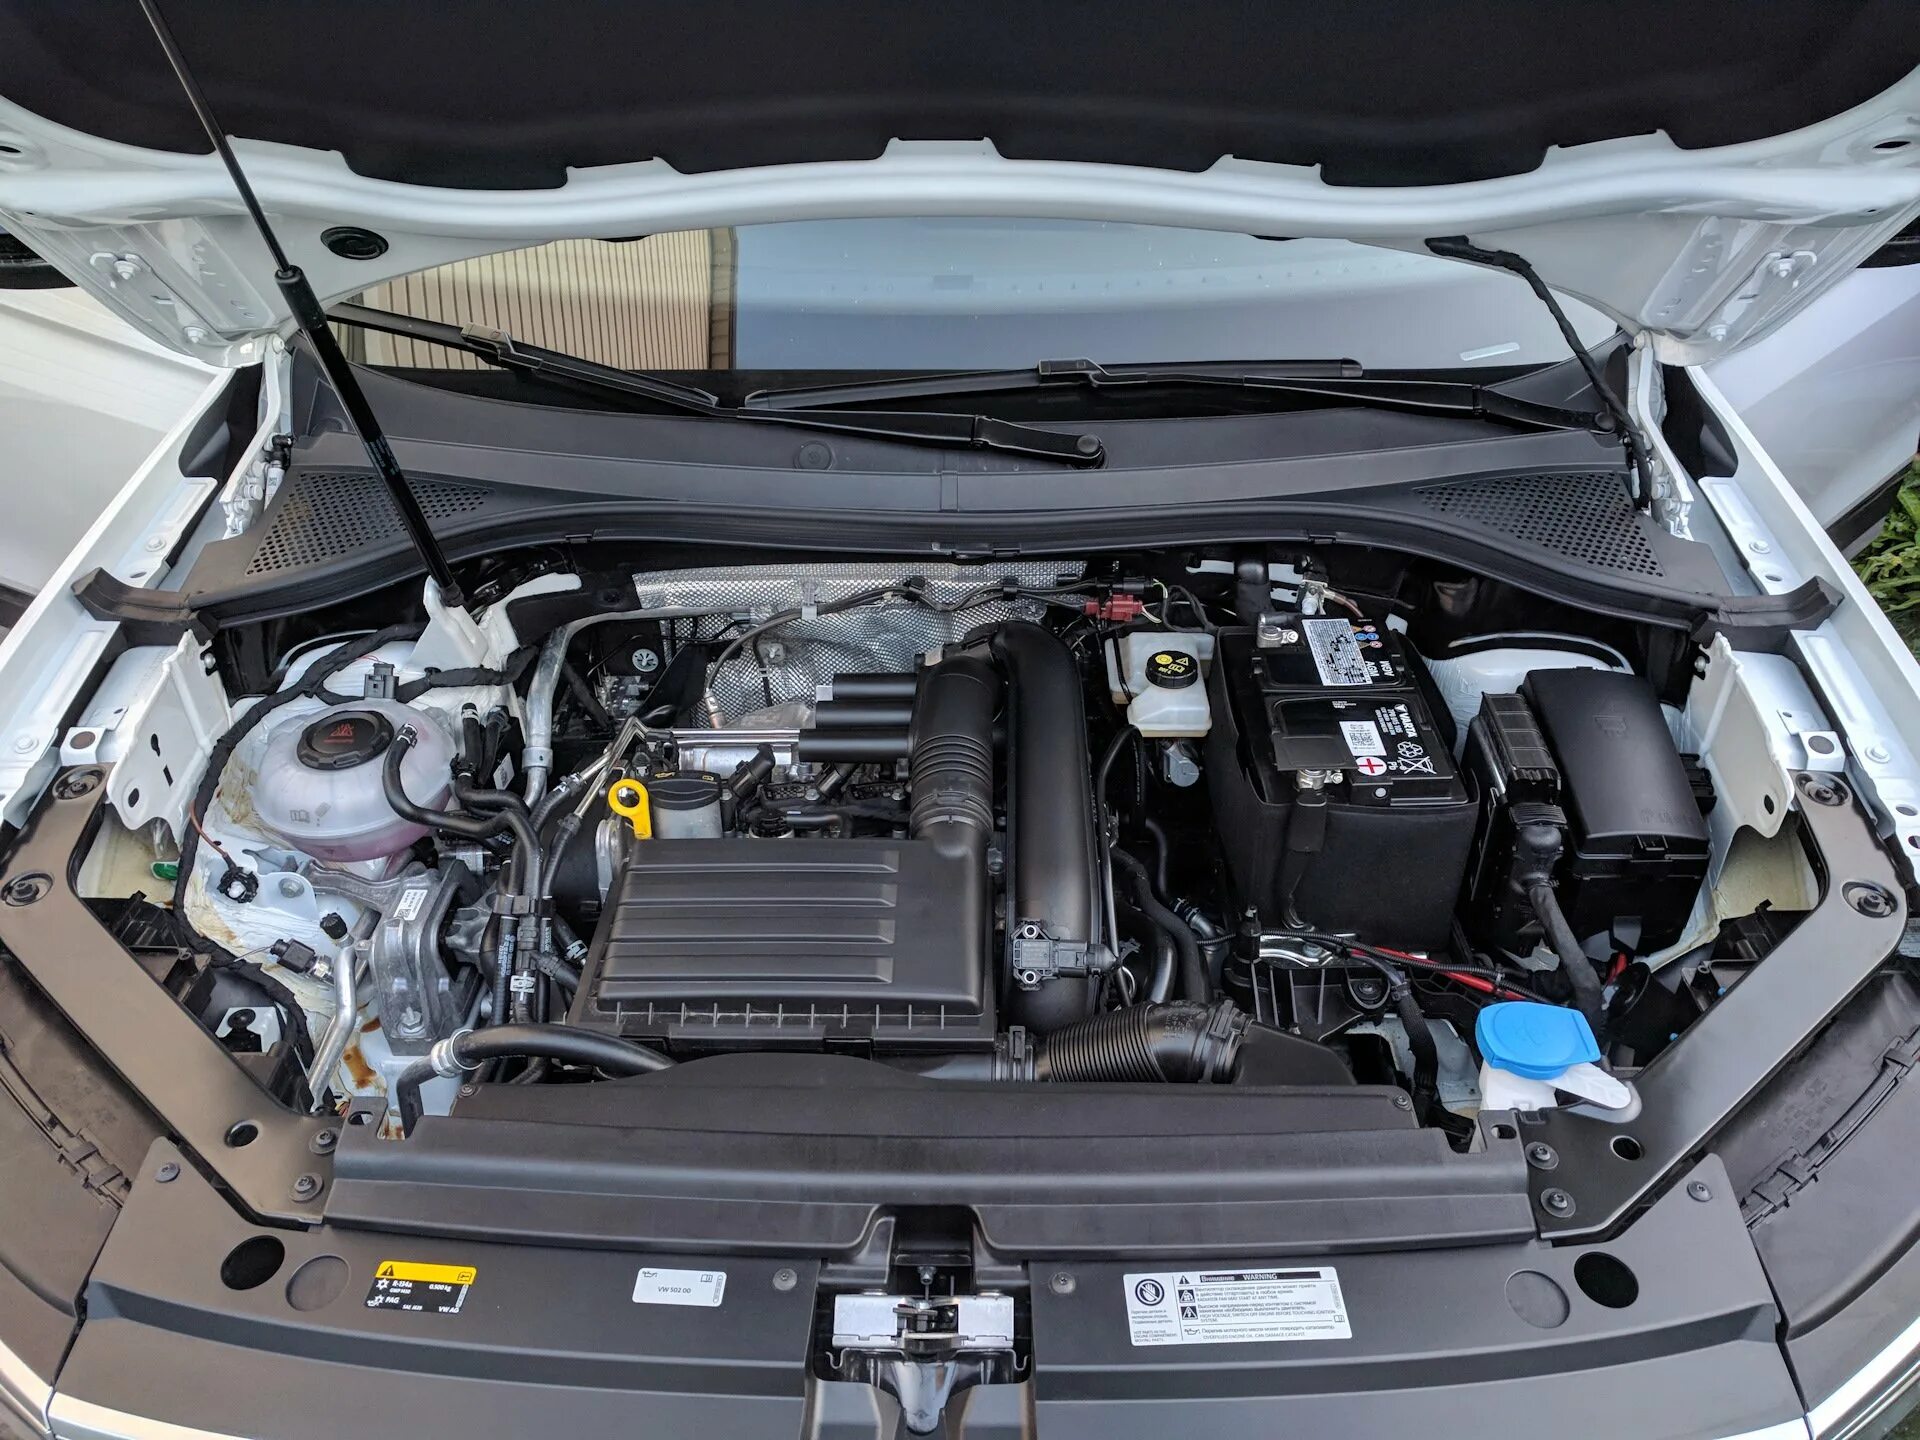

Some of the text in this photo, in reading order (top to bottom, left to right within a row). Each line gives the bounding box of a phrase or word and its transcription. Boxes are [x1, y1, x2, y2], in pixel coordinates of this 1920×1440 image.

[1365, 661, 1380, 677] AGM
[1399, 712, 1418, 738] VARTA
[1387, 761, 1398, 771] Pb
[385, 1296, 400, 1304] PAG
